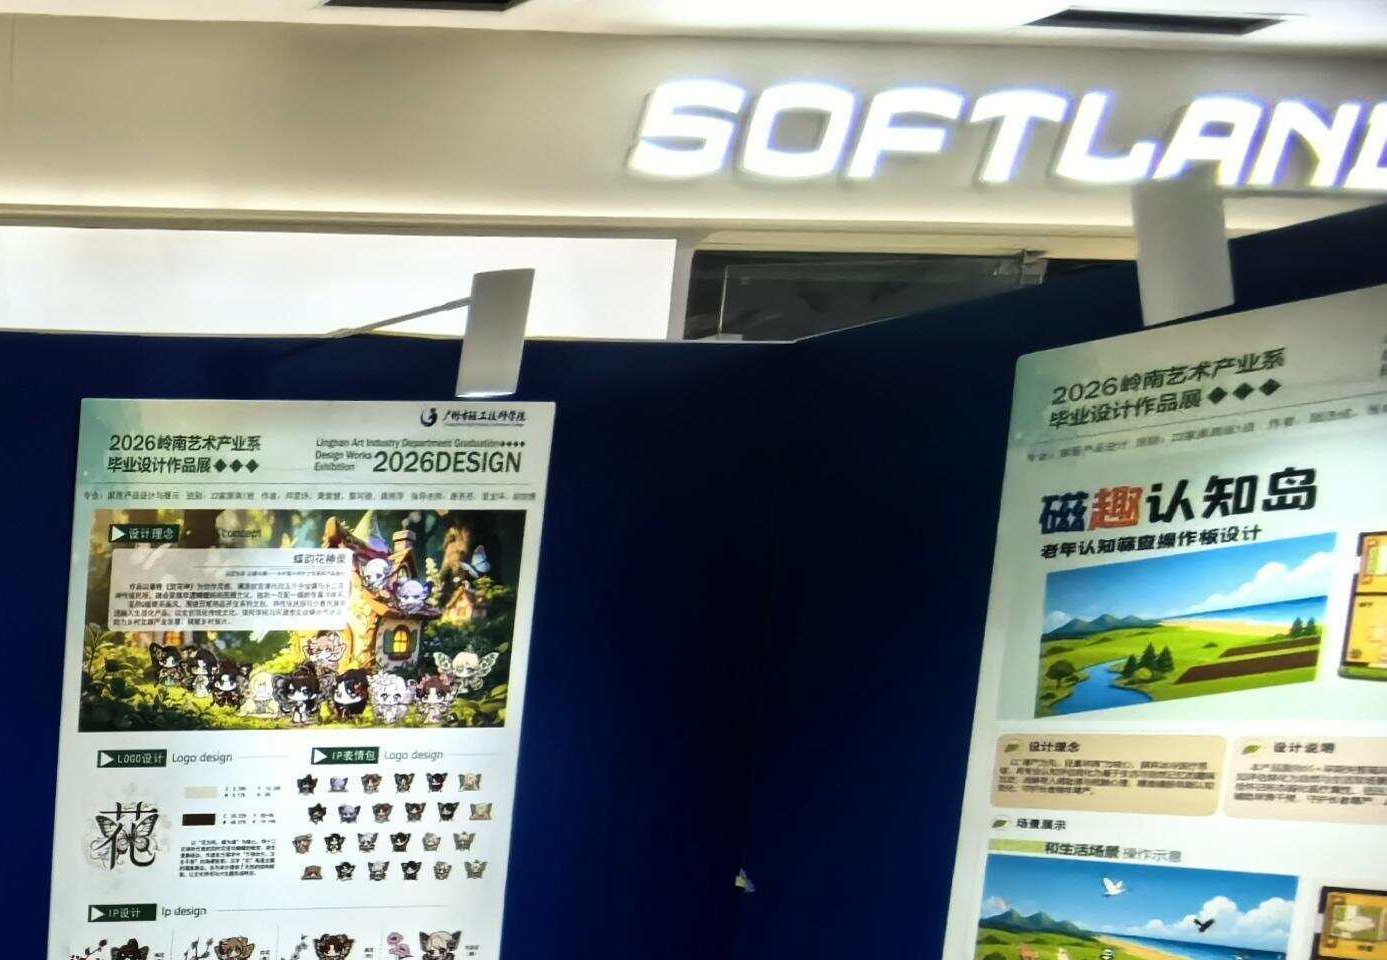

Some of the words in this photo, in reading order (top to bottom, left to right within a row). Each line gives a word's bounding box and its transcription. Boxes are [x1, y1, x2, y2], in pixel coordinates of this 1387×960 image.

[1051, 347, 1287, 405] 2026岭南艺术产业系
[1049, 387, 1201, 429] 毕业设计作品展
[109, 434, 261, 453] 2026岭南艺术产业系
[108, 456, 211, 474] 毕业设计作品展
[373, 451, 521, 473] 2026DESIGN
[1038, 467, 1318, 534] 磁趣认知岛
[172, 753, 197, 764] Logo
[199, 752, 233, 763] design
[385, 751, 408, 761] Logo
[411, 750, 444, 761] design
[174, 904, 207, 917] design
